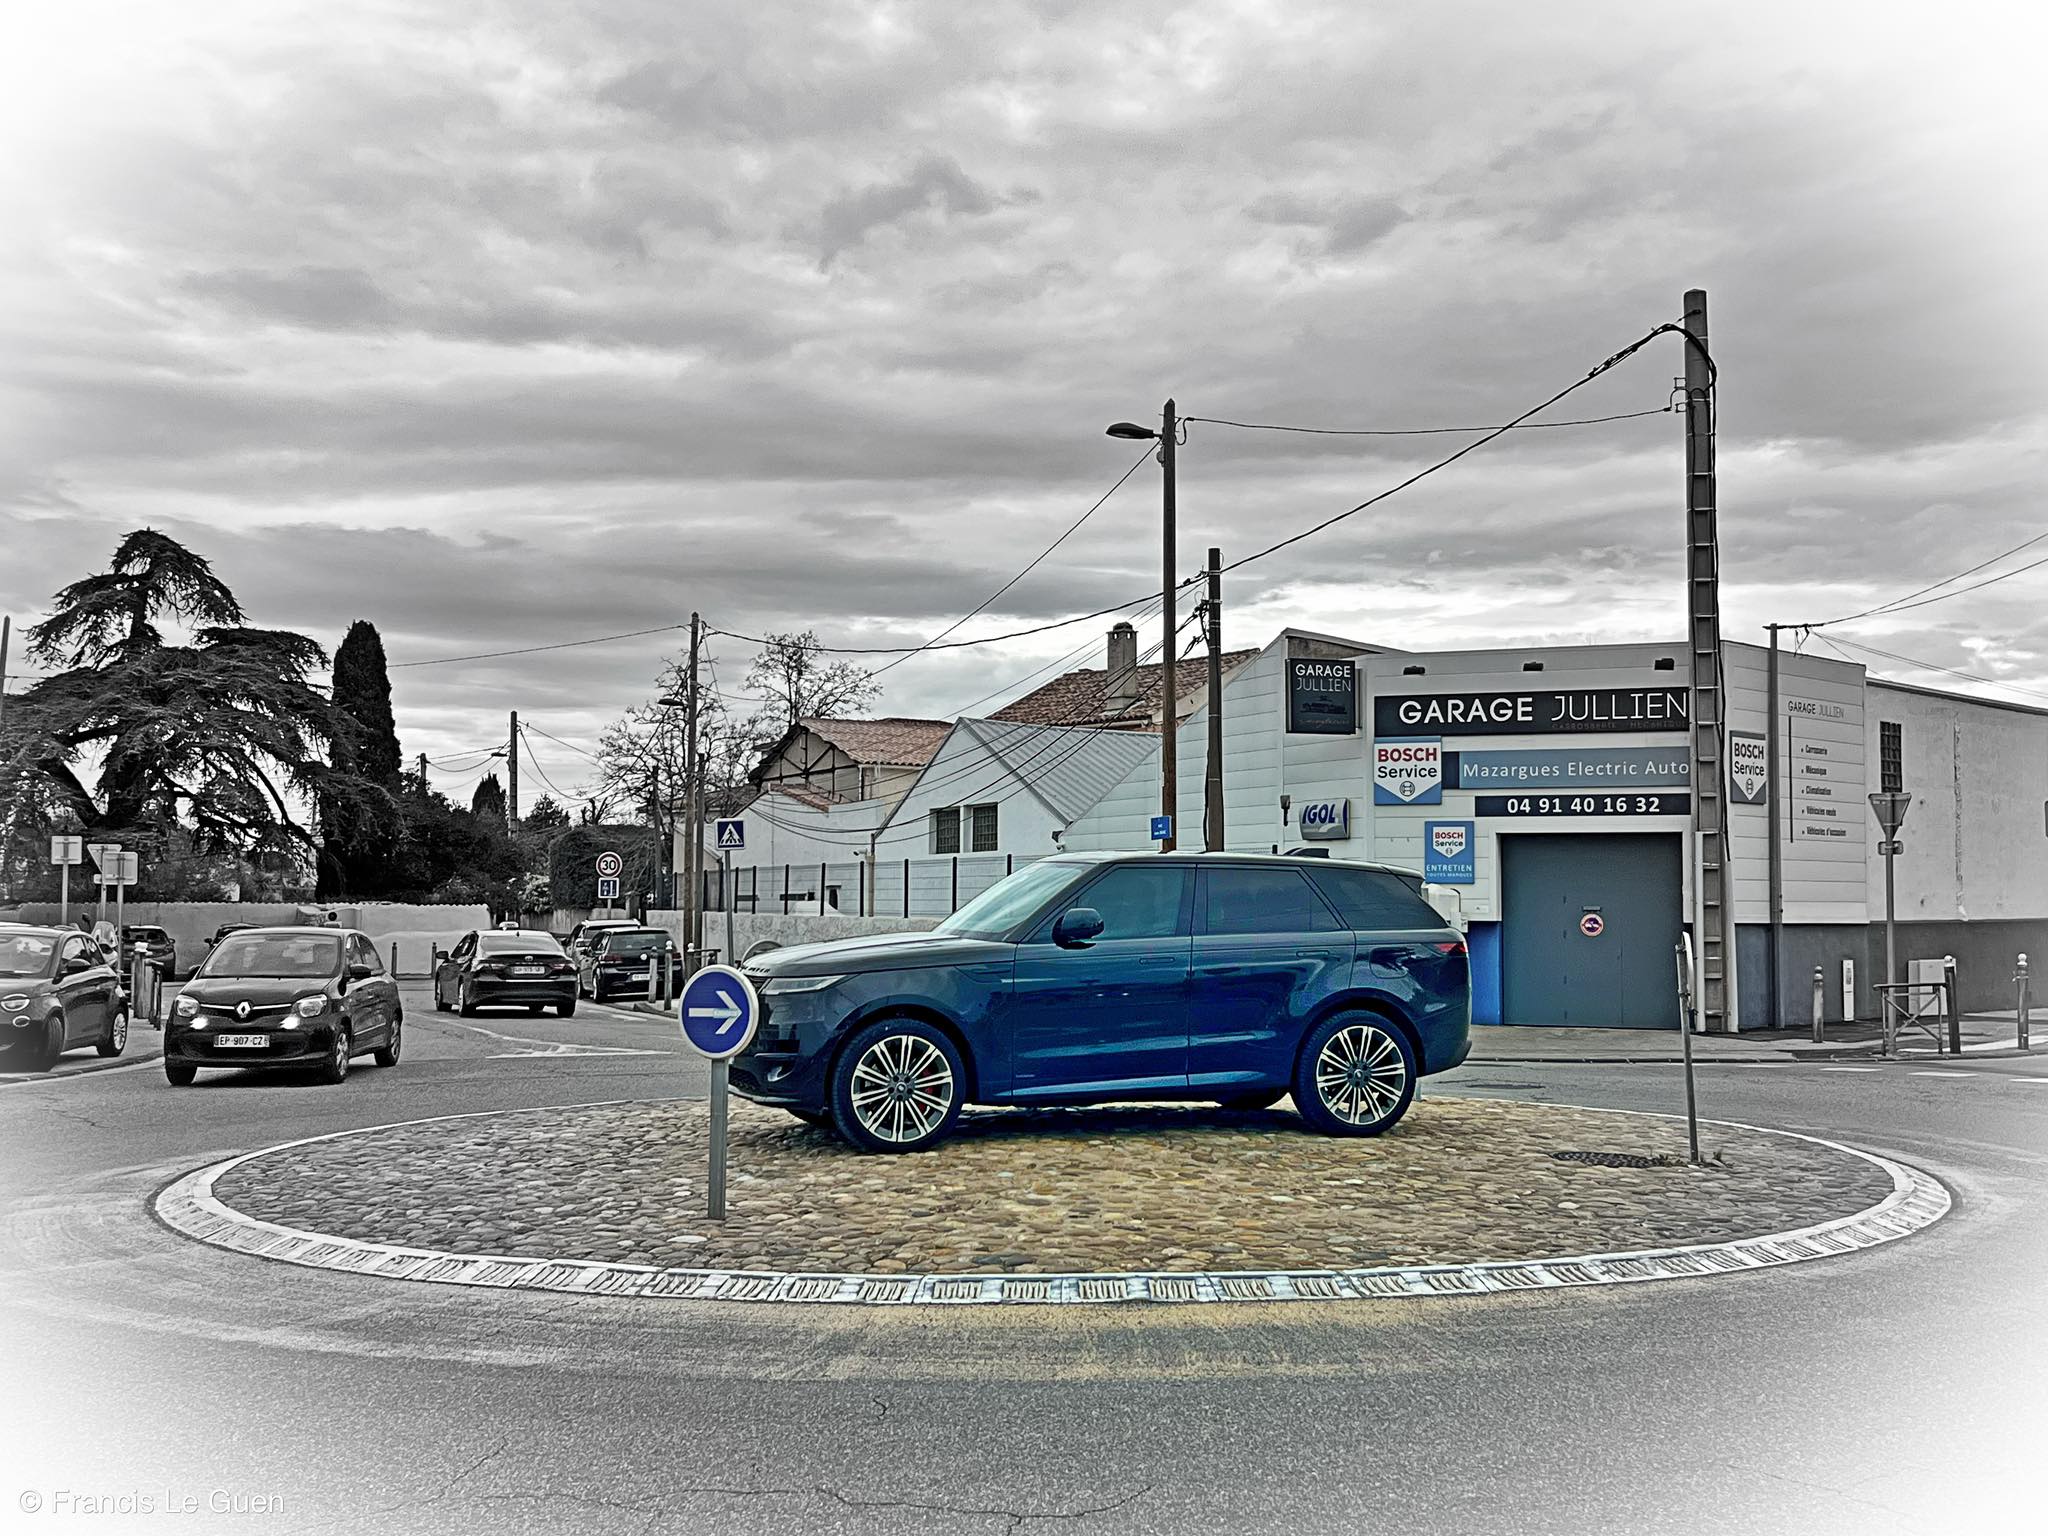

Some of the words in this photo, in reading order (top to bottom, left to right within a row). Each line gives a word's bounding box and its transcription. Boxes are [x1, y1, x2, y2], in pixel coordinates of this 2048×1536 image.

[1296, 664, 1351, 677] GARAGE
[1296, 678, 1351, 692] JULLIEN
[1399, 697, 1533, 724] GARAGE
[1551, 692, 1687, 721] JULLIEN
[1788, 701, 1816, 714] GARAGE
[1378, 747, 1437, 762] BOSCH
[1734, 742, 1764, 760] BOSCH
[1378, 764, 1437, 778] Service
[1463, 763, 1560, 780] Mazargues
[1568, 761, 1637, 776] Electric
[1645, 761, 1689, 775] Auto
[1734, 760, 1765, 776] Service
[1507, 798, 1531, 813] 04
[1539, 798, 1562, 813] 91
[1570, 797, 1595, 812] 40
[1603, 797, 1627, 812] 16
[1635, 797, 1660, 812] 32
[1302, 803, 1336, 824] IGOL
[602, 859, 616, 871] 30
[1426, 864, 1472, 872] ENTRETIEN
